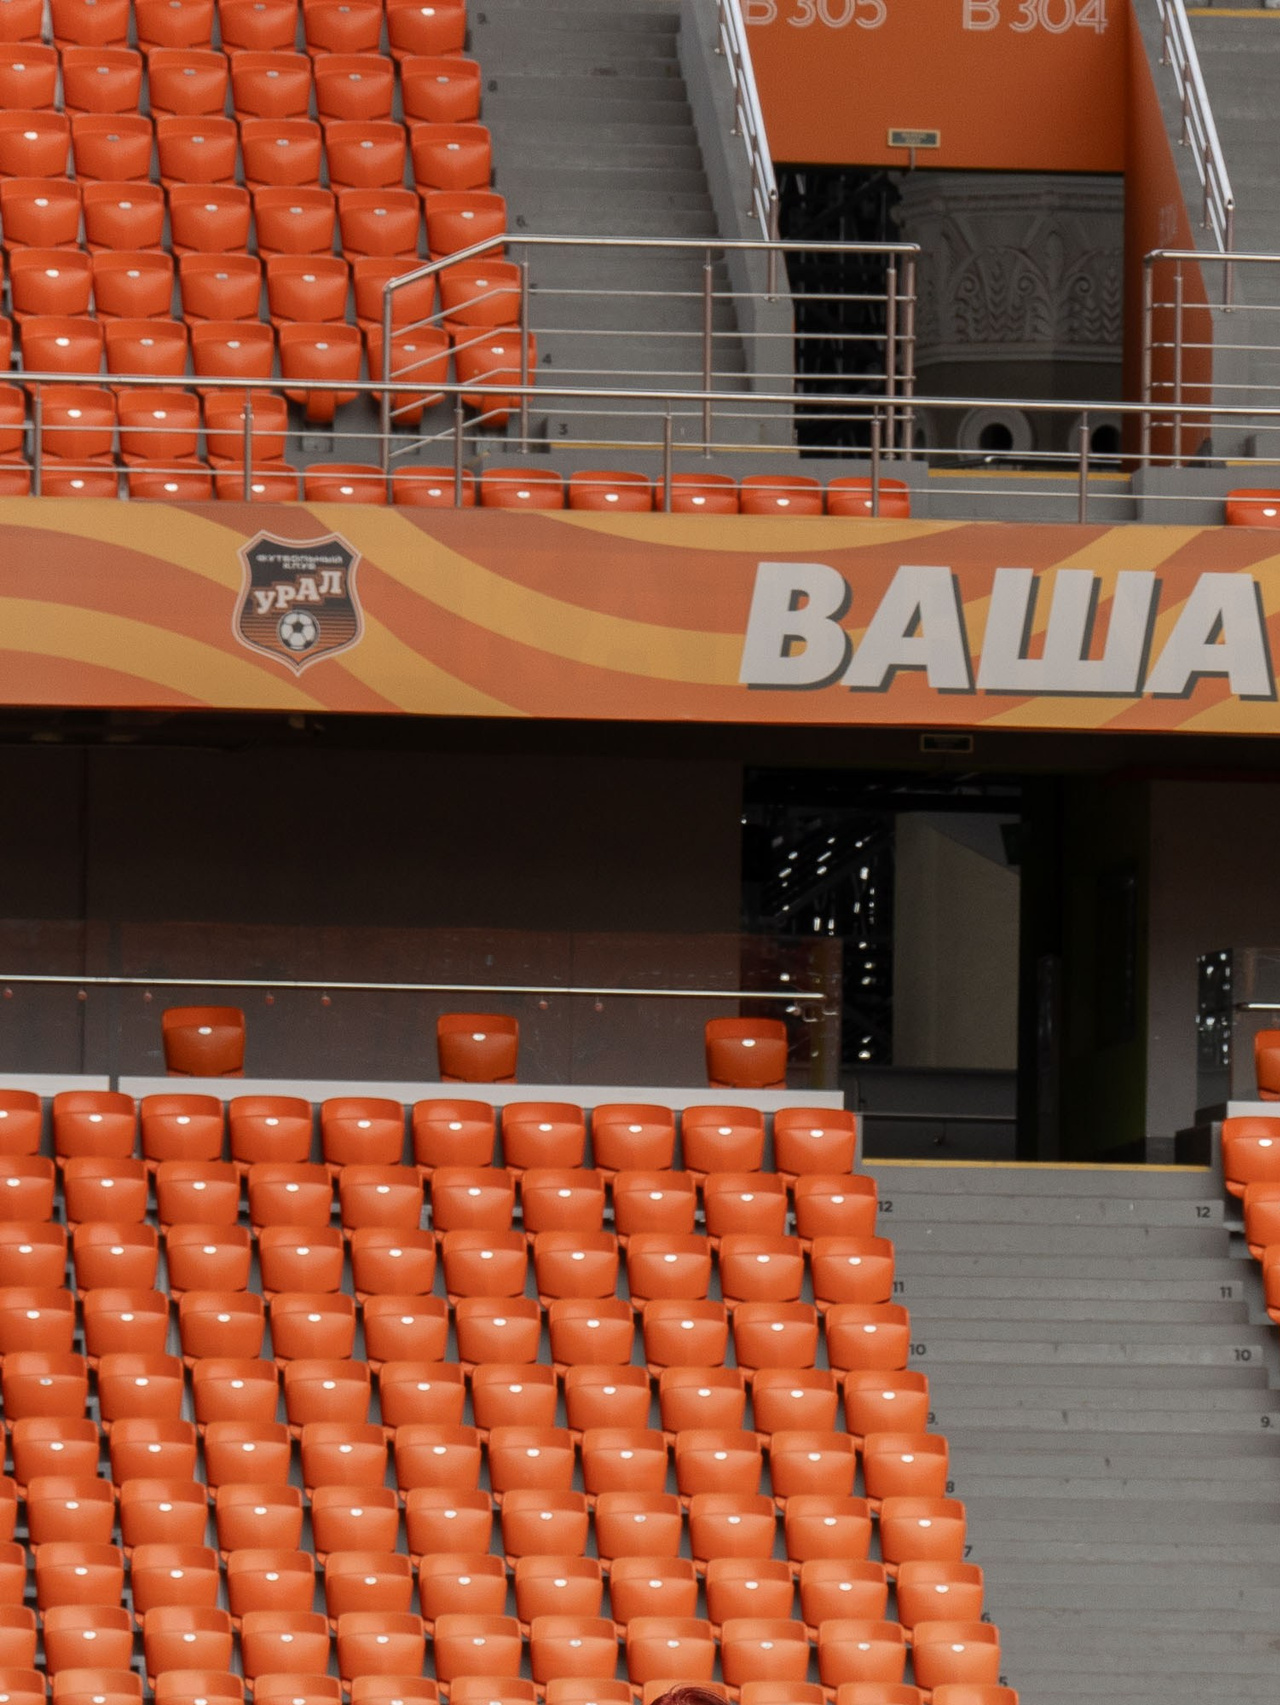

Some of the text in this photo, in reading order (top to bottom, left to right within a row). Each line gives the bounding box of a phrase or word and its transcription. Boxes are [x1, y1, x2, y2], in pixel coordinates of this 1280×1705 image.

[1008, 0, 1108, 35] 304
[558, 423, 568, 435] 3
[254, 570, 343, 615] УРАЛ
[738, 561, 1276, 700] ВАША
[877, 1201, 893, 1213] 12
[1195, 1206, 1211, 1218] 12
[892, 1281, 904, 1293] 11
[1220, 1286, 1232, 1298] 11
[909, 1343, 926, 1356] 10
[1234, 1349, 1251, 1361] 10
[964, 1545, 973, 1557] 7
